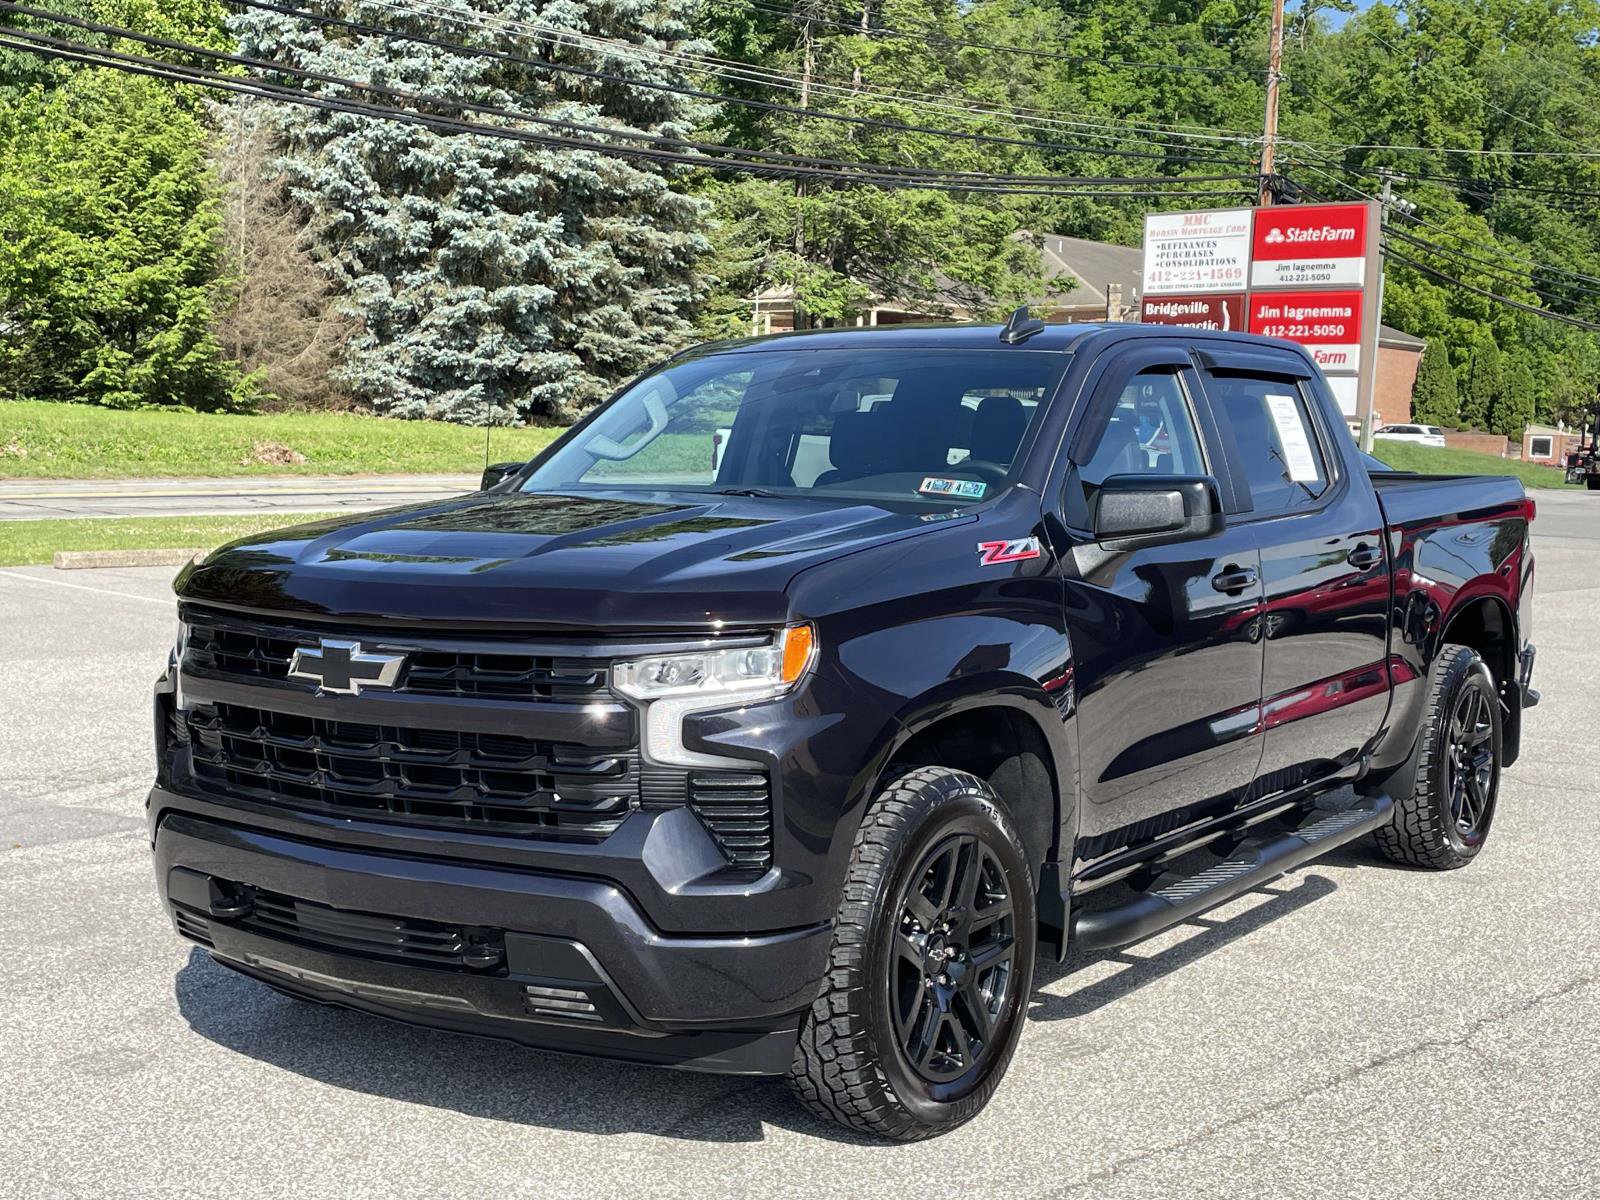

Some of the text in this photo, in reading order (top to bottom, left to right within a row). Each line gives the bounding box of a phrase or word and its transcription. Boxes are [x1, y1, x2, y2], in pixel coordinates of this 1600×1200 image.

[1183, 214, 1212, 226] MMC
[1160, 240, 1217, 250] REFINANCES
[1160, 250, 1214, 259] PURCHASES
[1159, 257, 1237, 268] CONSOLIDATIONS
[1276, 263, 1291, 272] Jim
[1149, 268, 1242, 282] 412-221-4569
[1280, 273, 1330, 282] 412-221-5050
[1145, 301, 1210, 317] Bridgeville
[1257, 305, 1352, 320] Jim Iagnemma
[1262, 325, 1345, 337] 412-221-5050
[977, 535, 1040, 567] Z71
